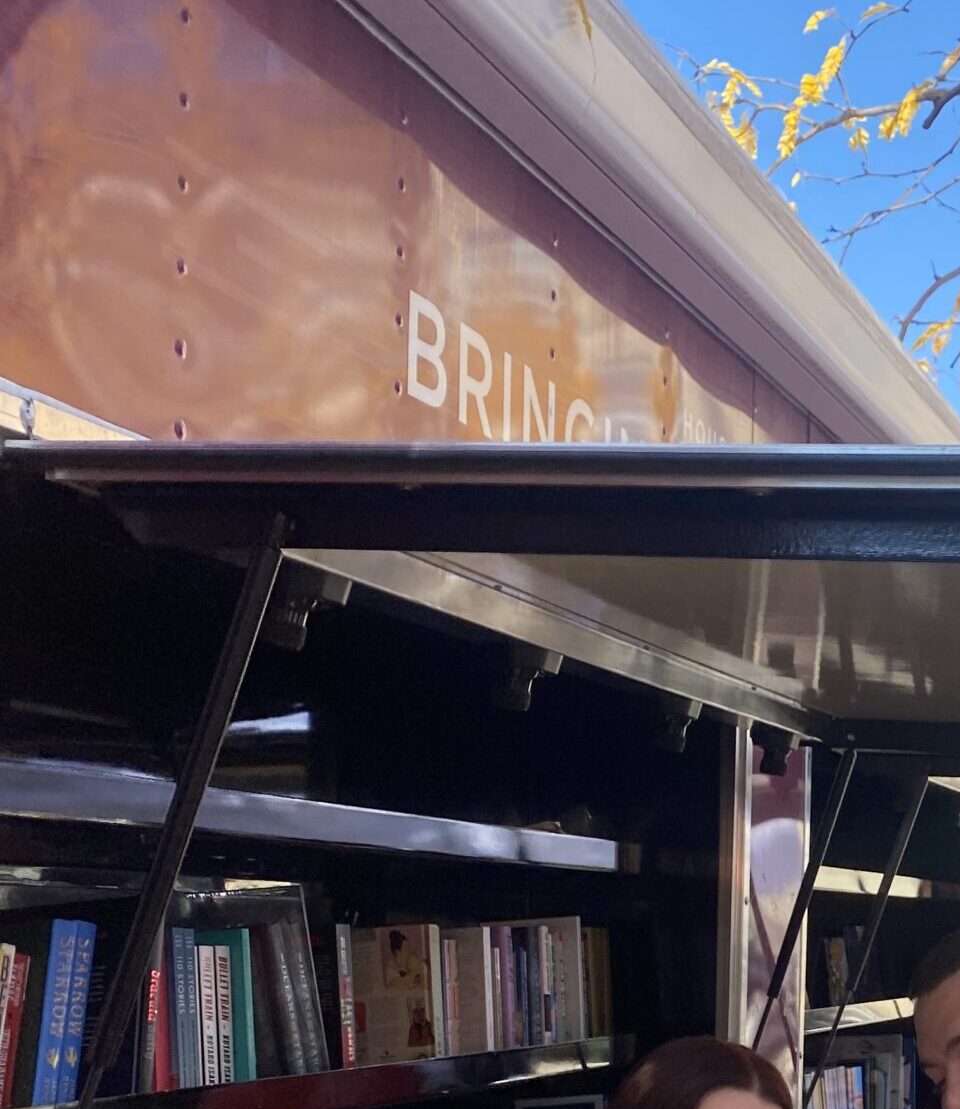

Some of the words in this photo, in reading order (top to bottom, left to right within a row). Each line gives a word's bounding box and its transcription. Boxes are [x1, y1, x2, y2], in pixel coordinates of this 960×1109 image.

[217, 955, 229, 992] BULLET
[203, 995, 215, 1022] TRAIN
[220, 993, 231, 1022] TRAIN
